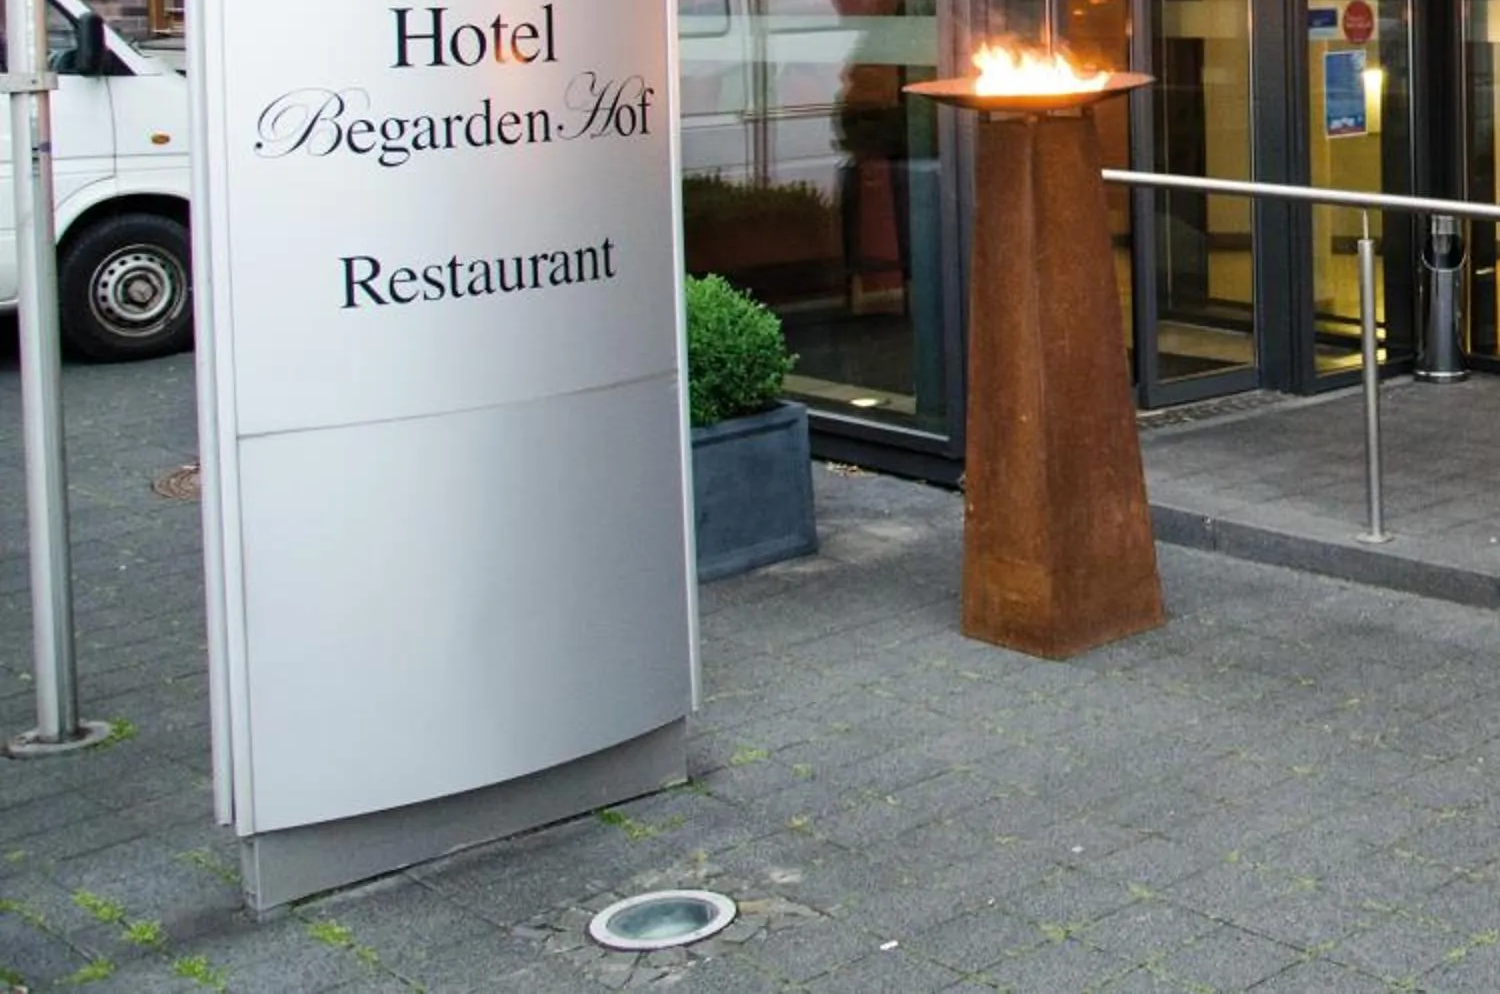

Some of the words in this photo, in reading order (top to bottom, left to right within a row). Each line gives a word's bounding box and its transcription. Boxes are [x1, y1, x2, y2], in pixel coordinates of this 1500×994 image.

[389, 3, 558, 69] Hotel
[254, 83, 551, 167] Begarden
[557, 71, 655, 142] Hof
[339, 237, 616, 308] Restaurant
